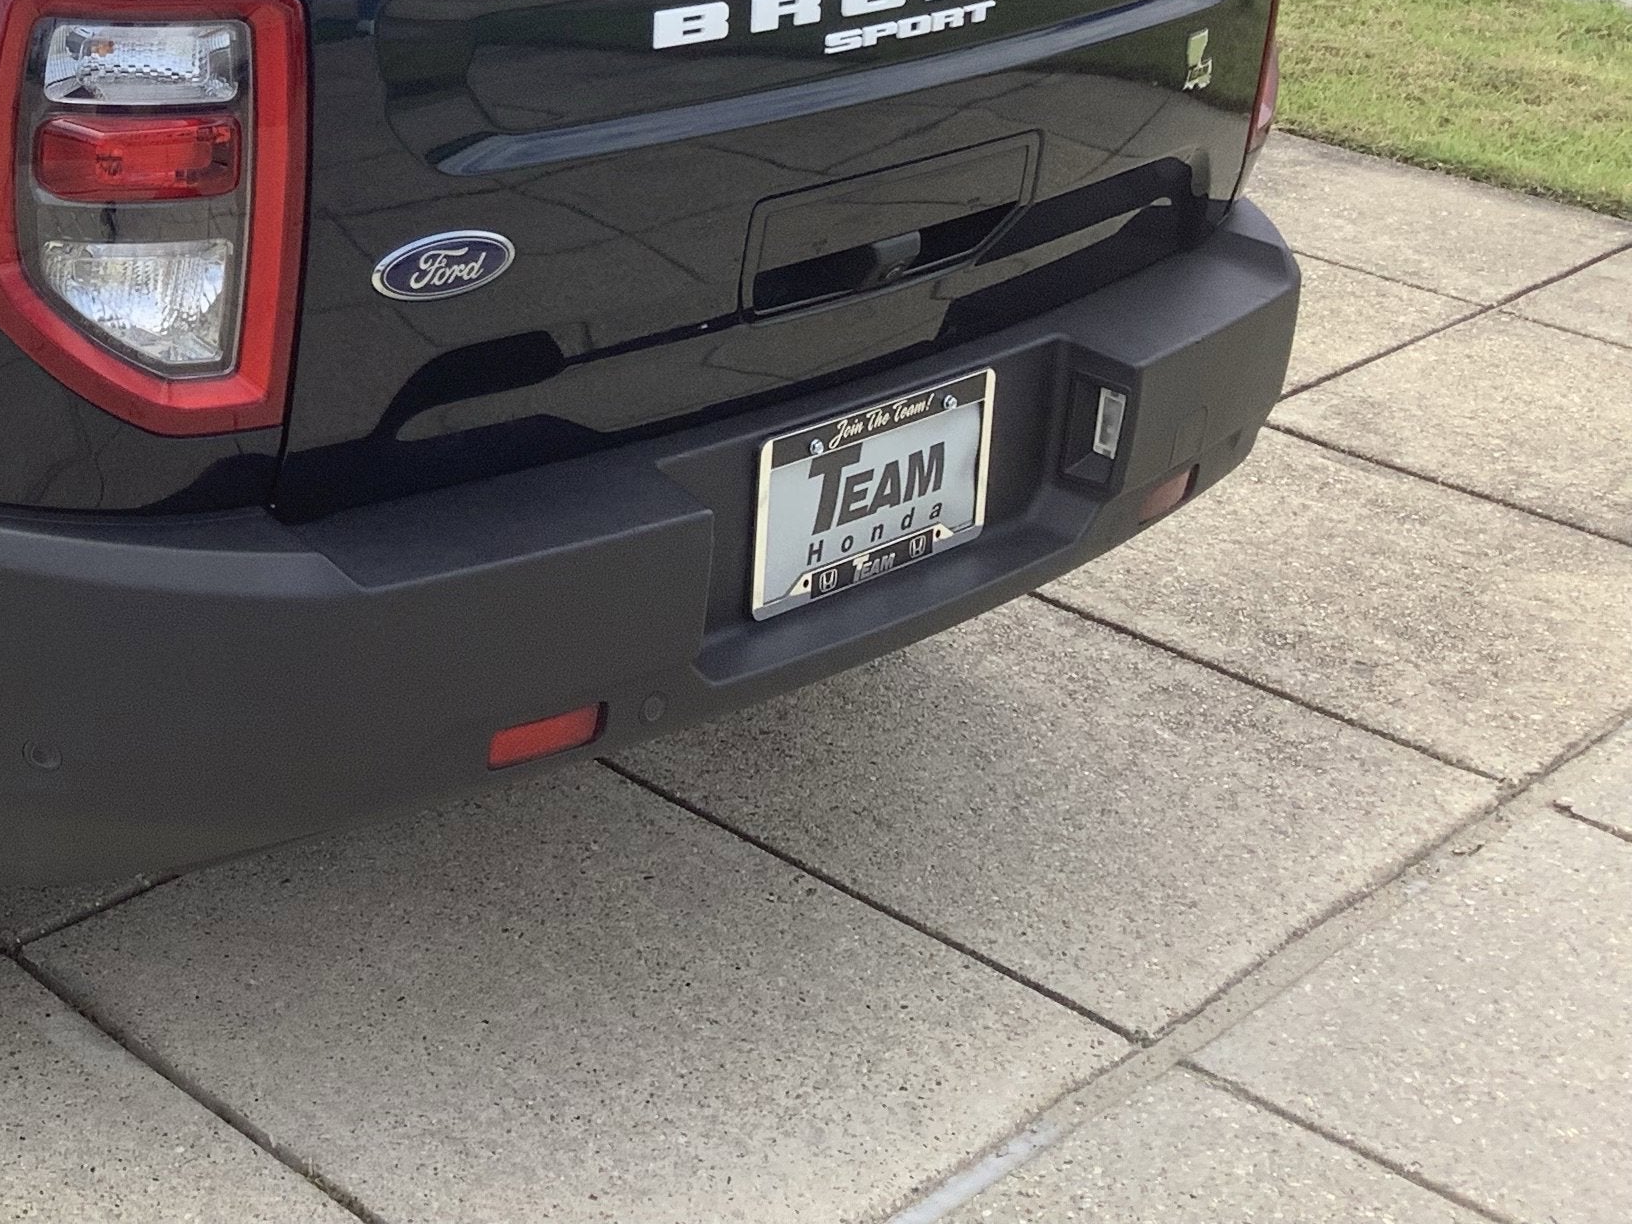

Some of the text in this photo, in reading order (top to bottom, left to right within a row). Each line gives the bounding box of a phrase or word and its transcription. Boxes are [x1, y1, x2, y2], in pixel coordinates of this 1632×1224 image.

[824, 0, 996, 55] SPORT
[409, 247, 487, 289] Ford
[829, 393, 934, 449] Join The Team!
[808, 442, 945, 536] TEAM
[806, 502, 943, 566] Honda
[852, 552, 896, 583] TEAM
